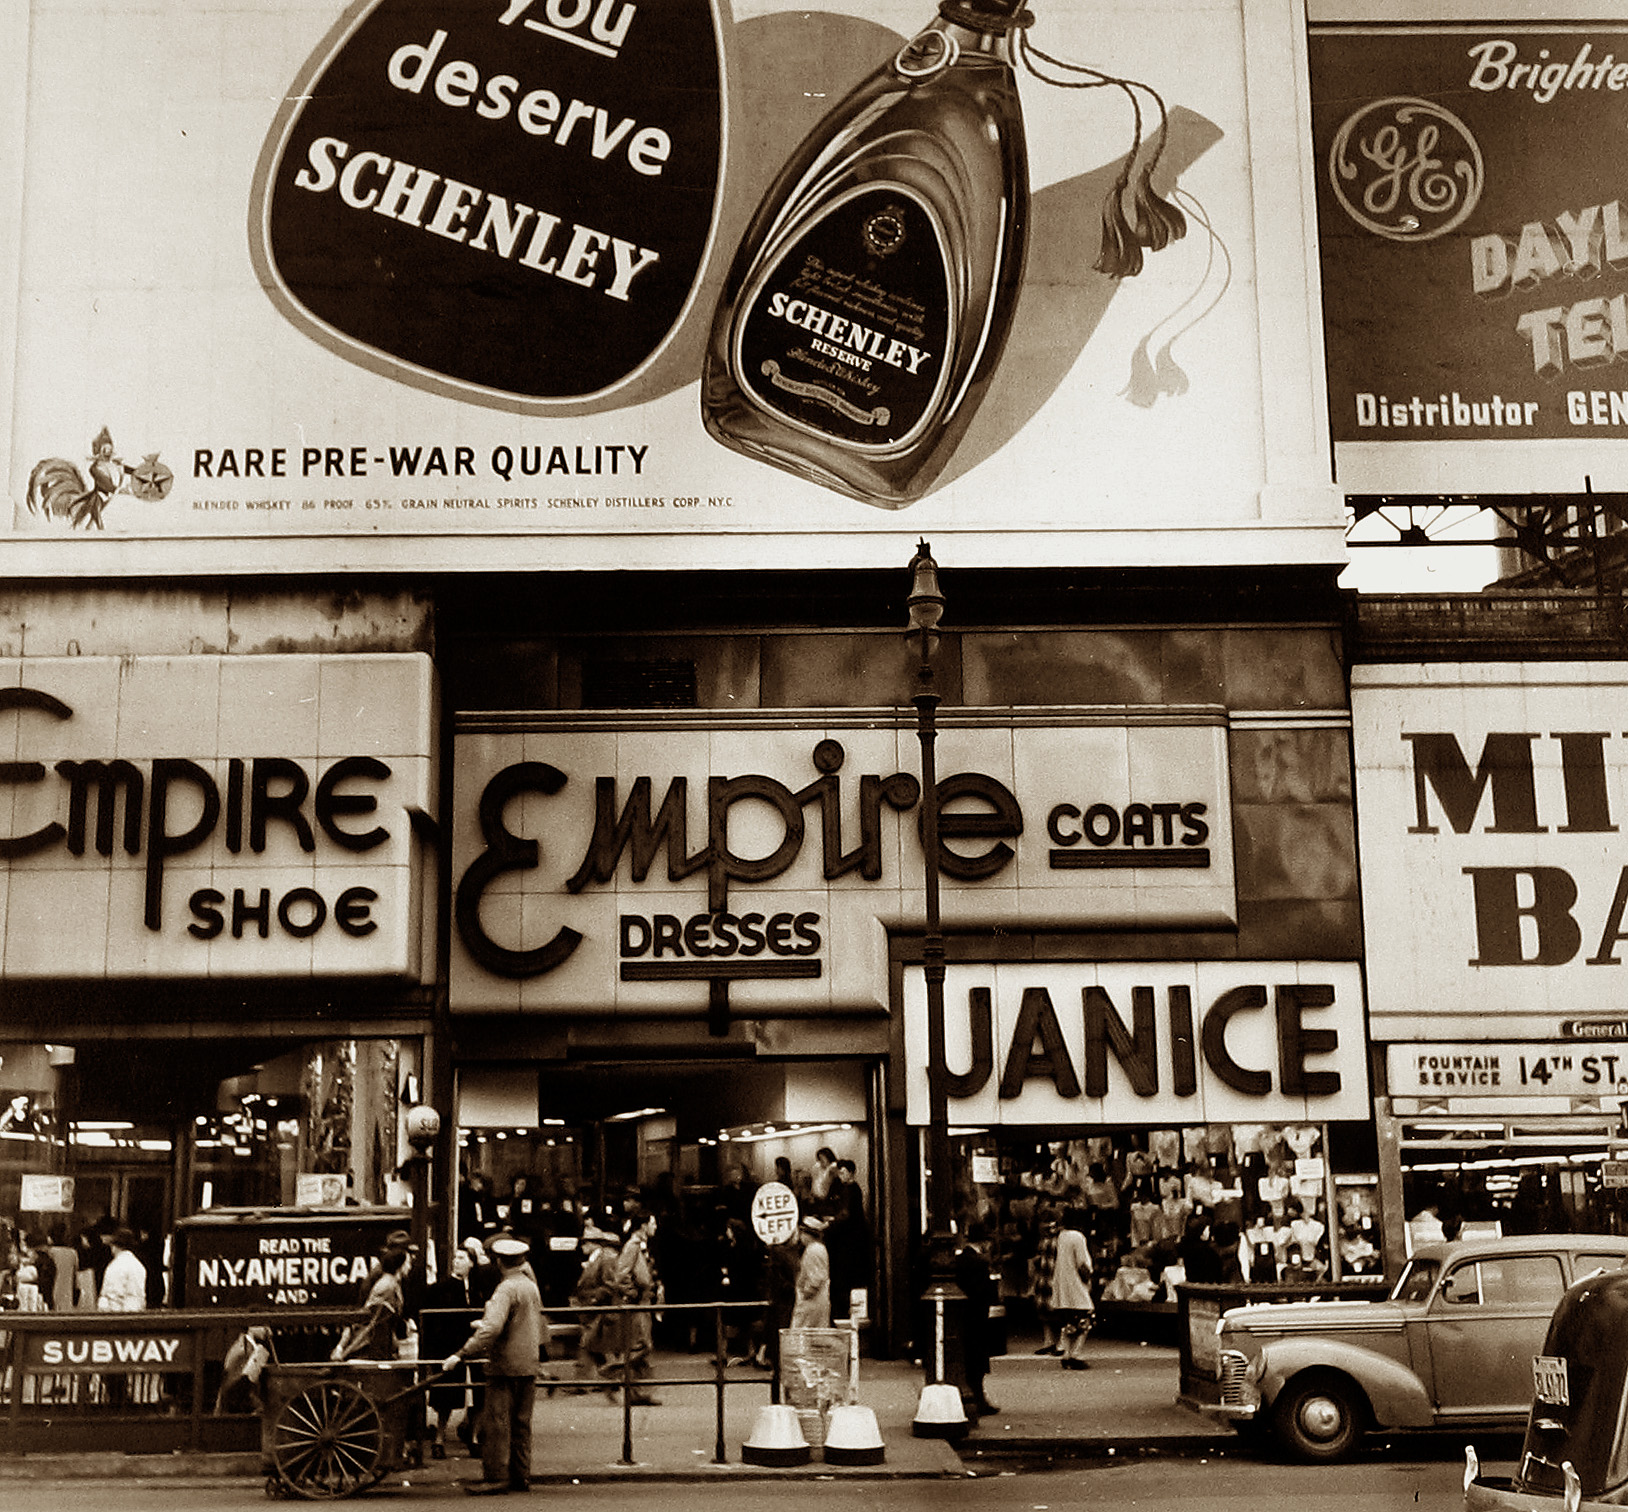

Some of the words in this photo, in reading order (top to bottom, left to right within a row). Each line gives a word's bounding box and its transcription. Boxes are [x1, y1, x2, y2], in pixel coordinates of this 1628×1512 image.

[497, 0, 637, 47] you
[387, 29, 672, 175] deserve
[294, 136, 660, 301] SCHENLEY
[1471, 200, 1628, 294] DAYL
[767, 292, 932, 375] SCHENLEY
[810, 338, 873, 372] RESERVE
[1356, 392, 1539, 427] Distributor
[1567, 391, 1628, 426] GEN
[193, 448, 287, 478] RARE
[302, 446, 476, 477] PRE-WAR
[491, 445, 649, 482] QUALITY
[193, 500, 239, 511] BLENDED
[246, 500, 291, 510] WHISKEY
[324, 499, 353, 510] PROOF
[401, 499, 438, 509] GRAIN
[443, 499, 491, 509] NEUTRAL
[496, 498, 538, 509] SPIRITS
[547, 498, 599, 509] SCHENLEY
[605, 497, 665, 508] DISTILLERS
[455, 738, 1023, 980] Empire
[1047, 802, 1210, 847] COATS
[187, 887, 379, 940] SHOE
[620, 912, 821, 958] DRESSES
[926, 984, 1341, 1099] JANICE
[1572, 1019, 1628, 1039] General
[1418, 1056, 1500, 1071] FOUNTAIN
[1519, 1056, 1573, 1086] 14TH
[1418, 1071, 1501, 1086] SERVICE
[758, 1194, 791, 1210] KEEP
[758, 1217, 793, 1236] LEFT
[259, 1238, 300, 1254] READ
[302, 1237, 331, 1253] THE
[43, 1339, 180, 1364] SUBWAY
